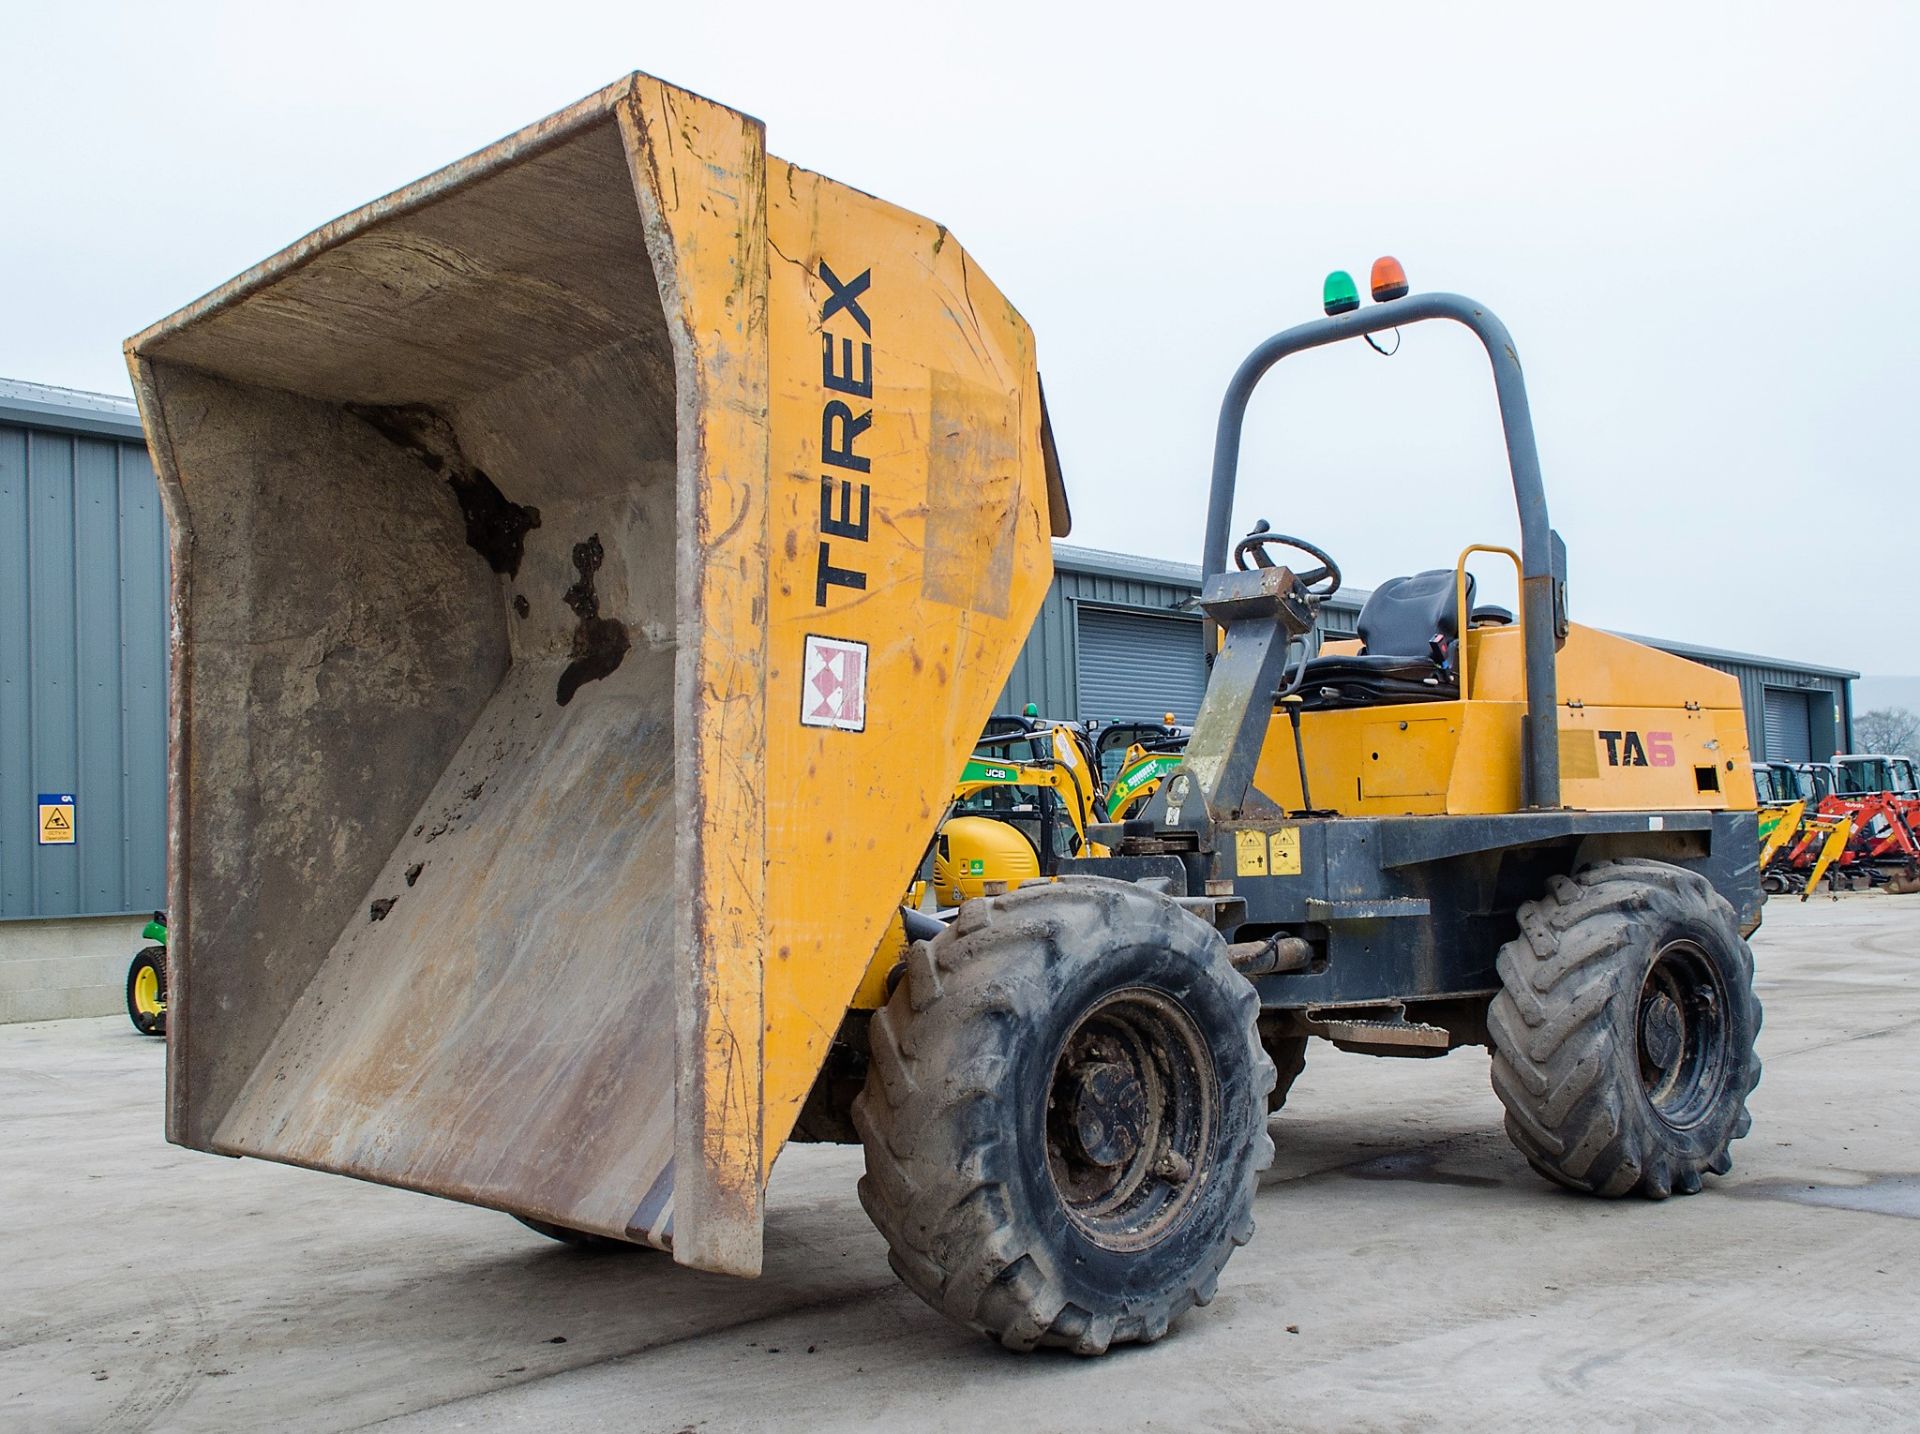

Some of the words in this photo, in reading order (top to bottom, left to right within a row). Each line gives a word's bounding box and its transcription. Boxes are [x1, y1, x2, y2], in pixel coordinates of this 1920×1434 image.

[815, 256, 873, 608] TEREX
[1598, 730, 1676, 768] TA6
[985, 768, 1006, 779] JCB
